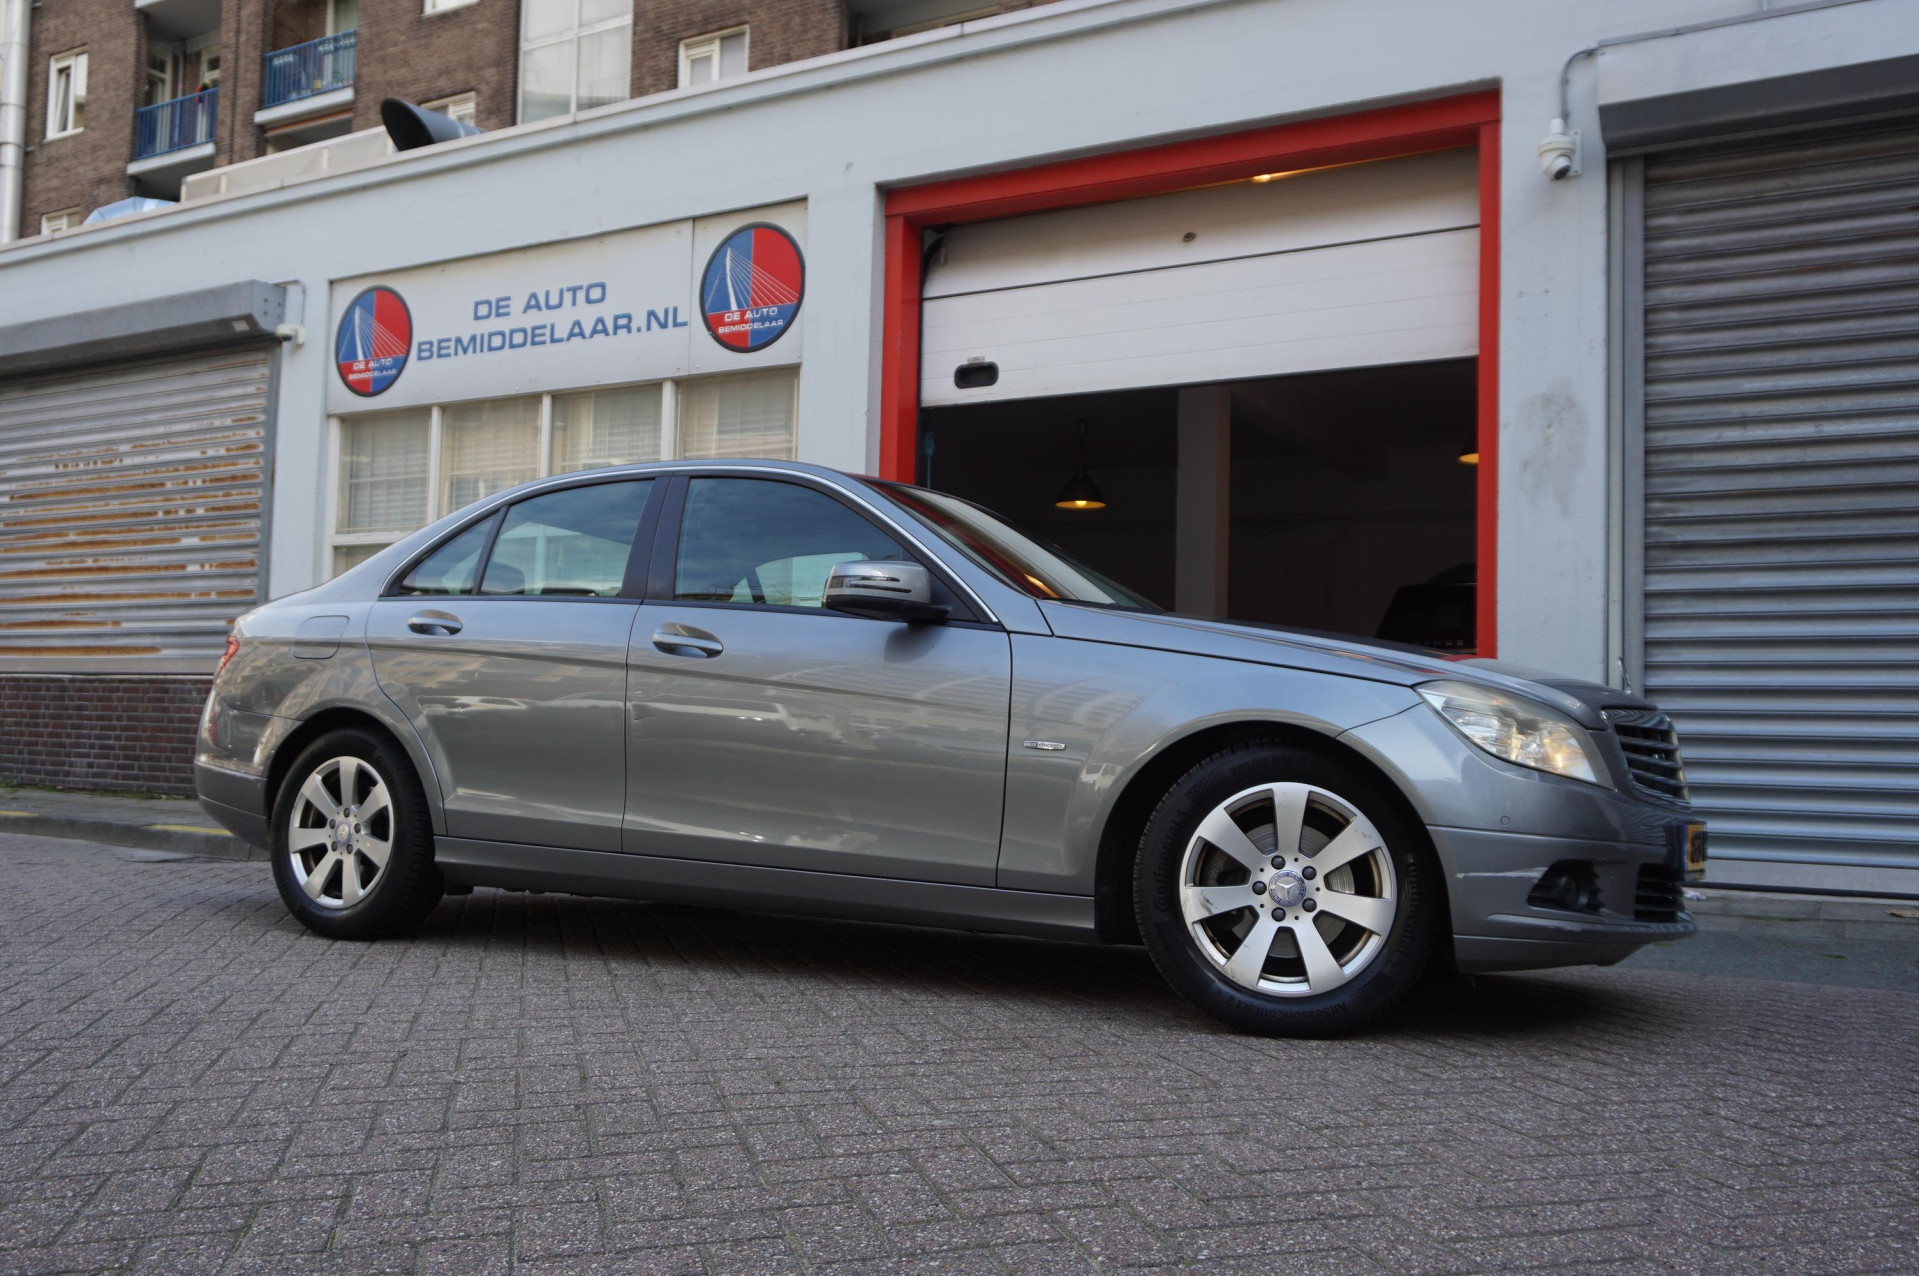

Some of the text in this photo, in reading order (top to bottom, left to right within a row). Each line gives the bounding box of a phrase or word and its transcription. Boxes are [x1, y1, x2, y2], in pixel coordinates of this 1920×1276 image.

[473, 281, 607, 321] DE AUTO
[724, 306, 778, 322] DE AUTO
[416, 305, 689, 361] BEMIDDELAAR.NL
[718, 319, 784, 334] BEMIDDELAAR
[352, 357, 393, 371] DE AUTO
[348, 368, 398, 380] BEMIDDELAAR
[1154, 819, 1183, 911] Continental
